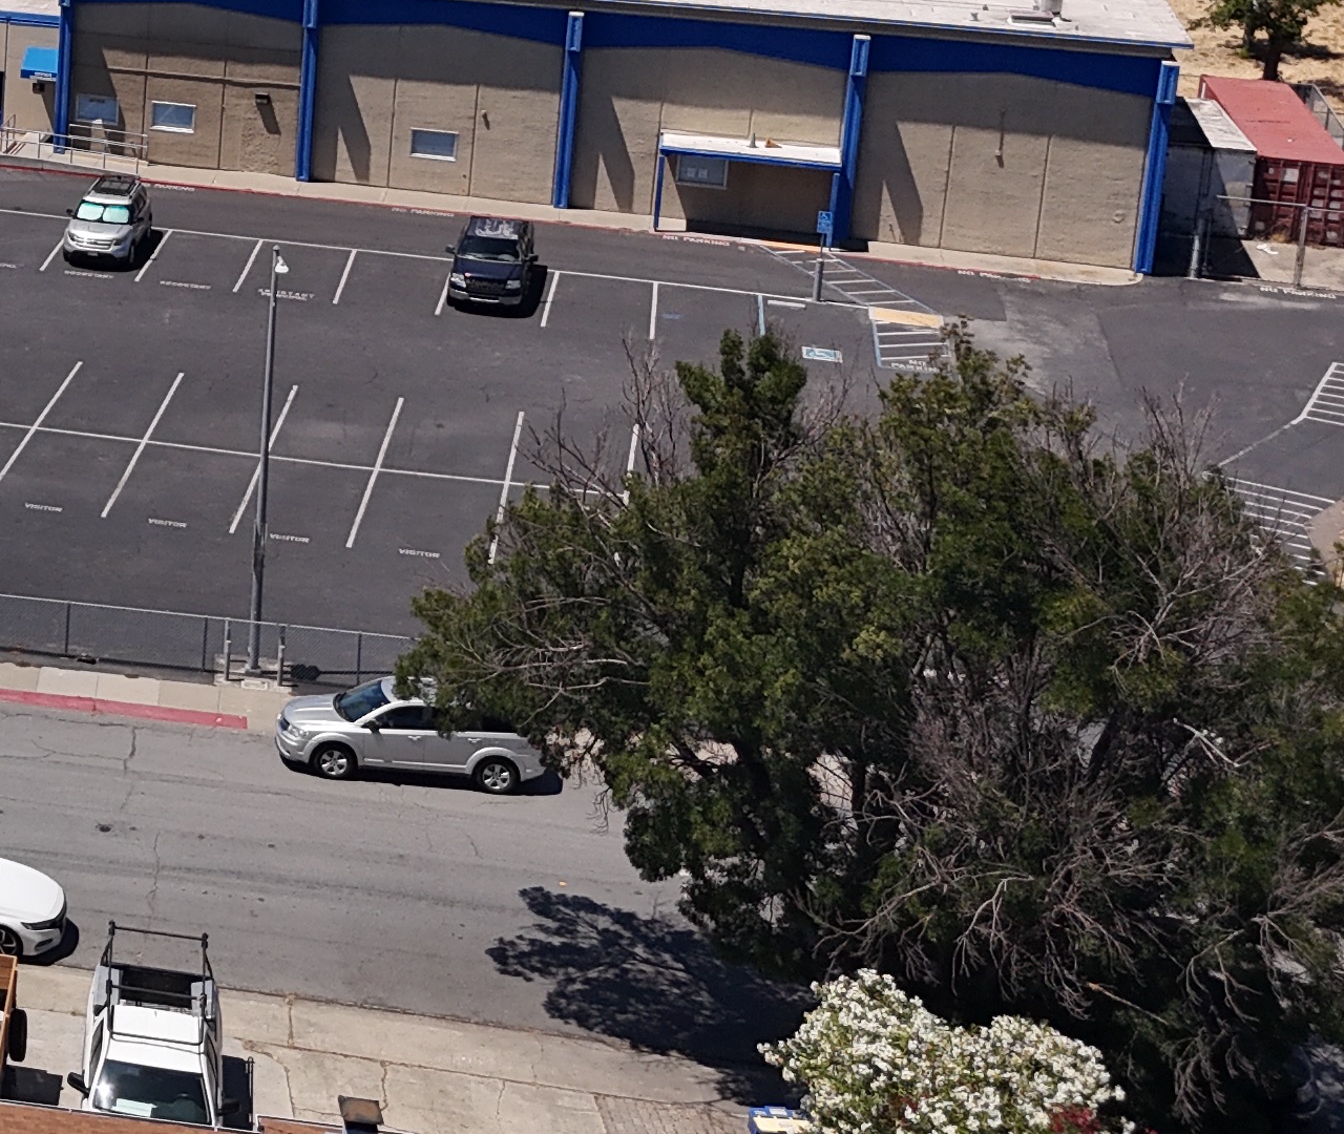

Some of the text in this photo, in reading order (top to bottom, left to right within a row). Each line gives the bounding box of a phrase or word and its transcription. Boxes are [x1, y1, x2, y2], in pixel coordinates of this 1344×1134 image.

[24, 502, 63, 513] VISITOR
[148, 517, 188, 528] VISITOR
[269, 532, 310, 544] VISITOR
[398, 547, 441, 559] VISITOR
